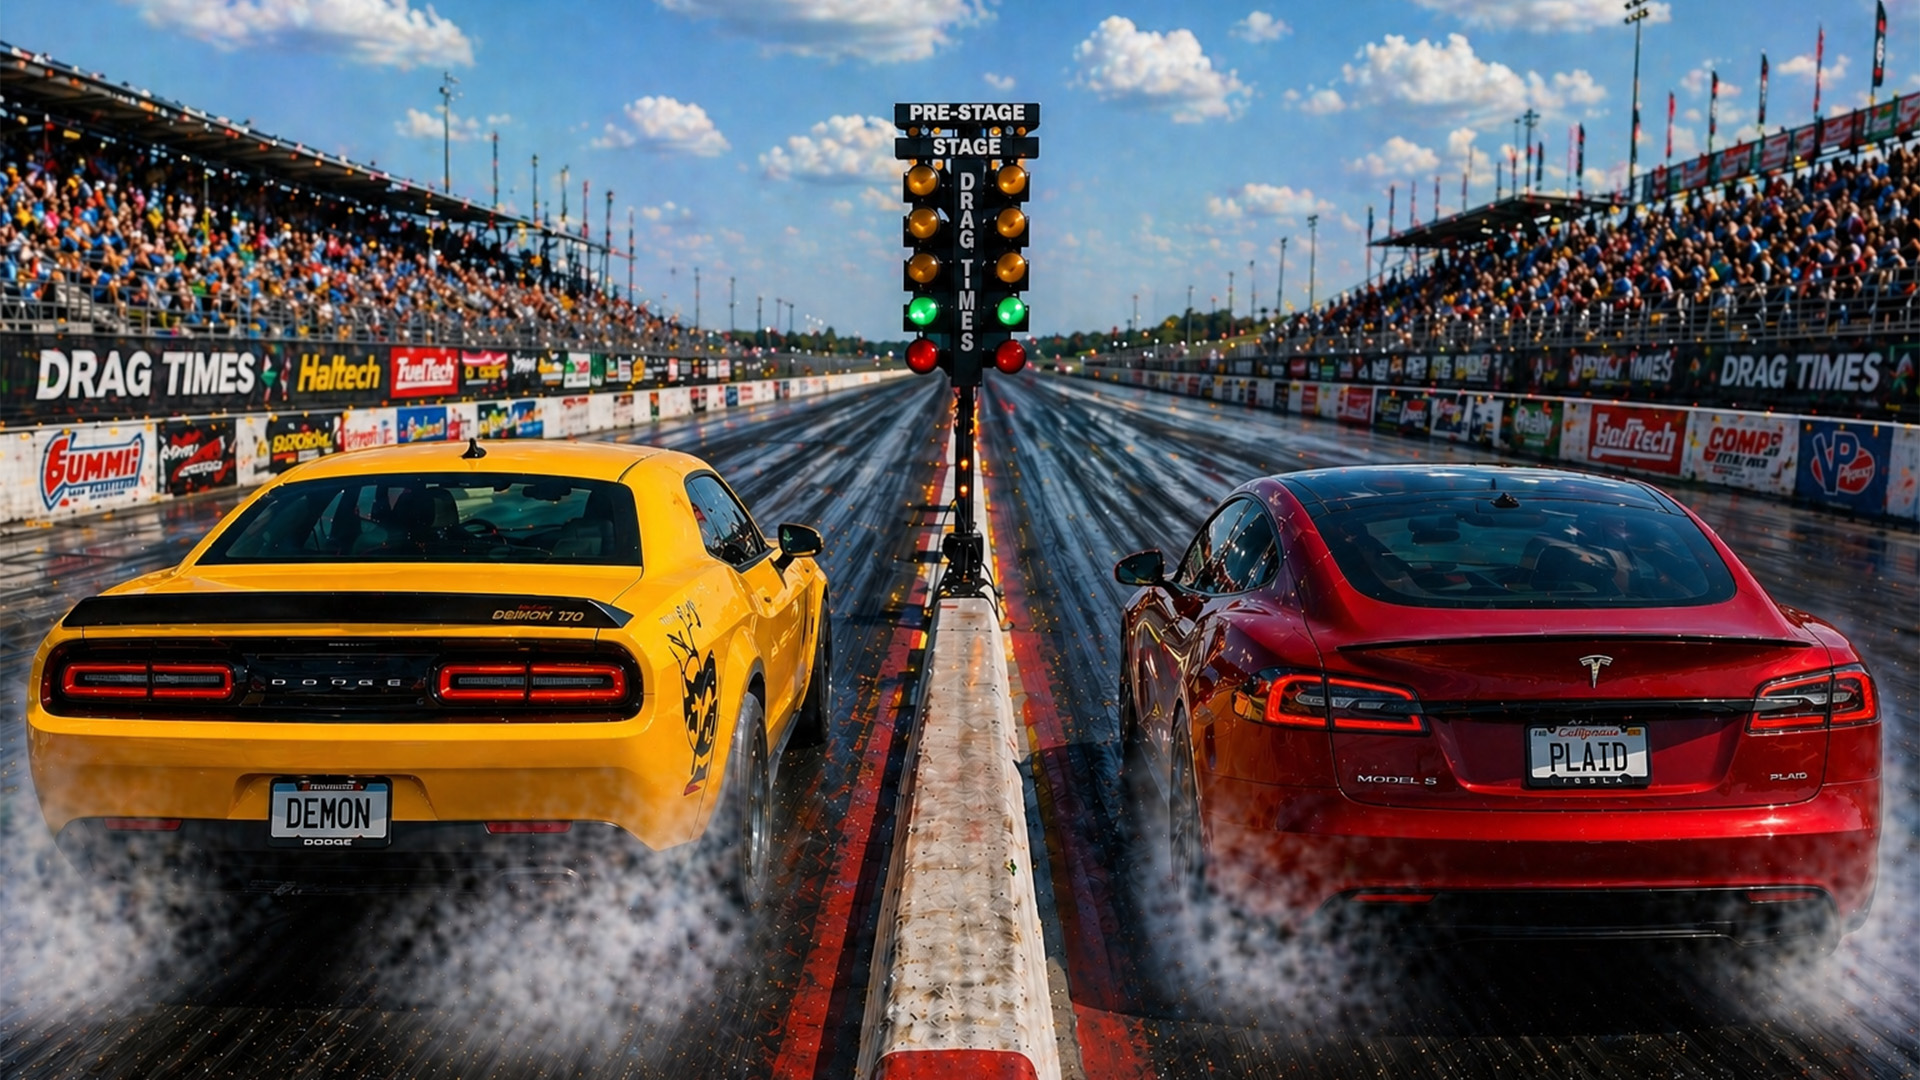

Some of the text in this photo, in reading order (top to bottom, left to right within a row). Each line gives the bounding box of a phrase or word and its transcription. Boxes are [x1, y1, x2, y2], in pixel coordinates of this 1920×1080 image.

[909, 104, 1025, 121] PRE-STAGE
[932, 138, 1001, 155] STAGE
[959, 172, 975, 352] DRAG TIMES
[36, 350, 256, 400] DRAG TIMES
[297, 354, 381, 392] Haltech
[1720, 353, 1883, 393] DRAG TIMES
[1812, 431, 1861, 496] VP
[1549, 742, 1628, 772] PLAID
[1357, 775, 1438, 785] MODEL S
[1770, 772, 1808, 780] PLAID
[286, 797, 371, 829] DEMON
